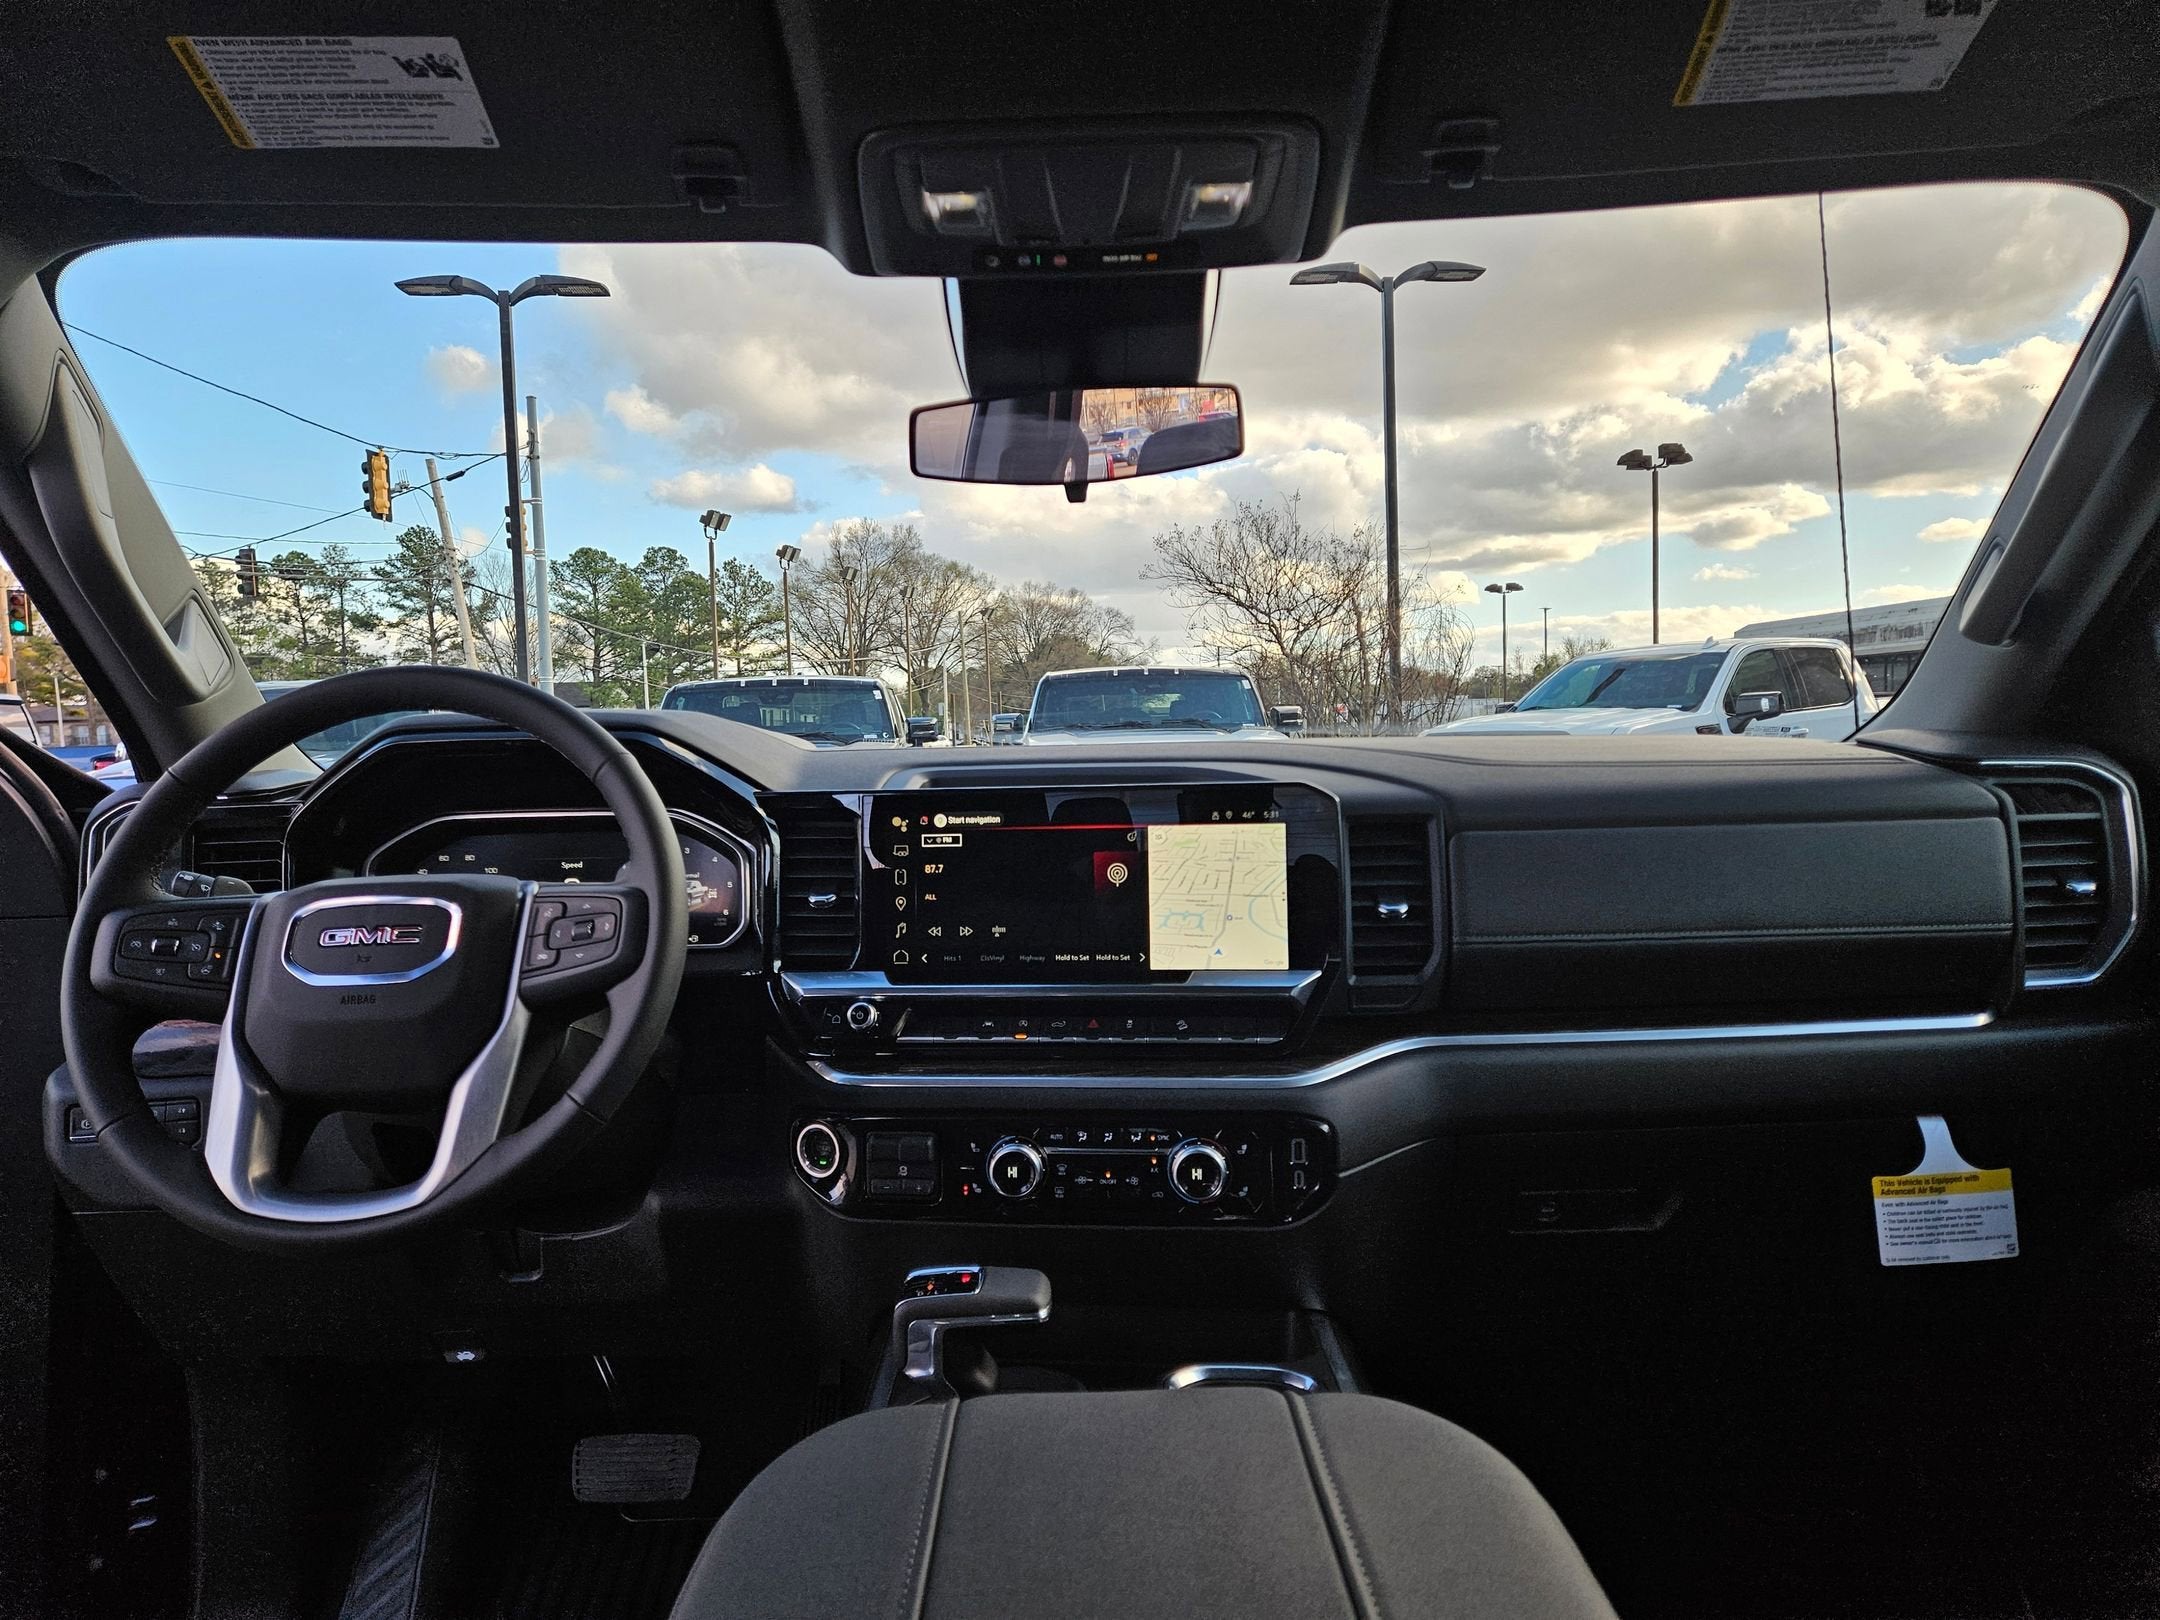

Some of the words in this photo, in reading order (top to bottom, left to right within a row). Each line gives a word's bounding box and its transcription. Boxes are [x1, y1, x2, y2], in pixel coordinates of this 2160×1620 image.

[948, 815, 965, 824] Start
[965, 815, 1001, 825] navigation
[561, 861, 583, 870] Speed
[924, 864, 944, 874] 87.7
[924, 893, 937, 901] ALL
[319, 926, 423, 947] GMC
[1019, 954, 1046, 963] Highway
[1055, 954, 1070, 962] Hold
[1079, 954, 1090, 962] Set
[1095, 954, 1111, 962] Hold
[1120, 954, 1131, 962] Set
[340, 995, 377, 1006] AIRBAG
[1007, 1166, 1018, 1179] HI
[1191, 1168, 1203, 1181] HI
[1880, 1179, 1895, 1188] This
[1897, 1177, 1923, 1187] Vehicle
[1931, 1175, 1963, 1186] Equipped
[1964, 1174, 1981, 1182] with
[1880, 1186, 1916, 1196] Advanced
[1918, 1185, 1928, 1194] Air
[1928, 1185, 1947, 1196] Bags
